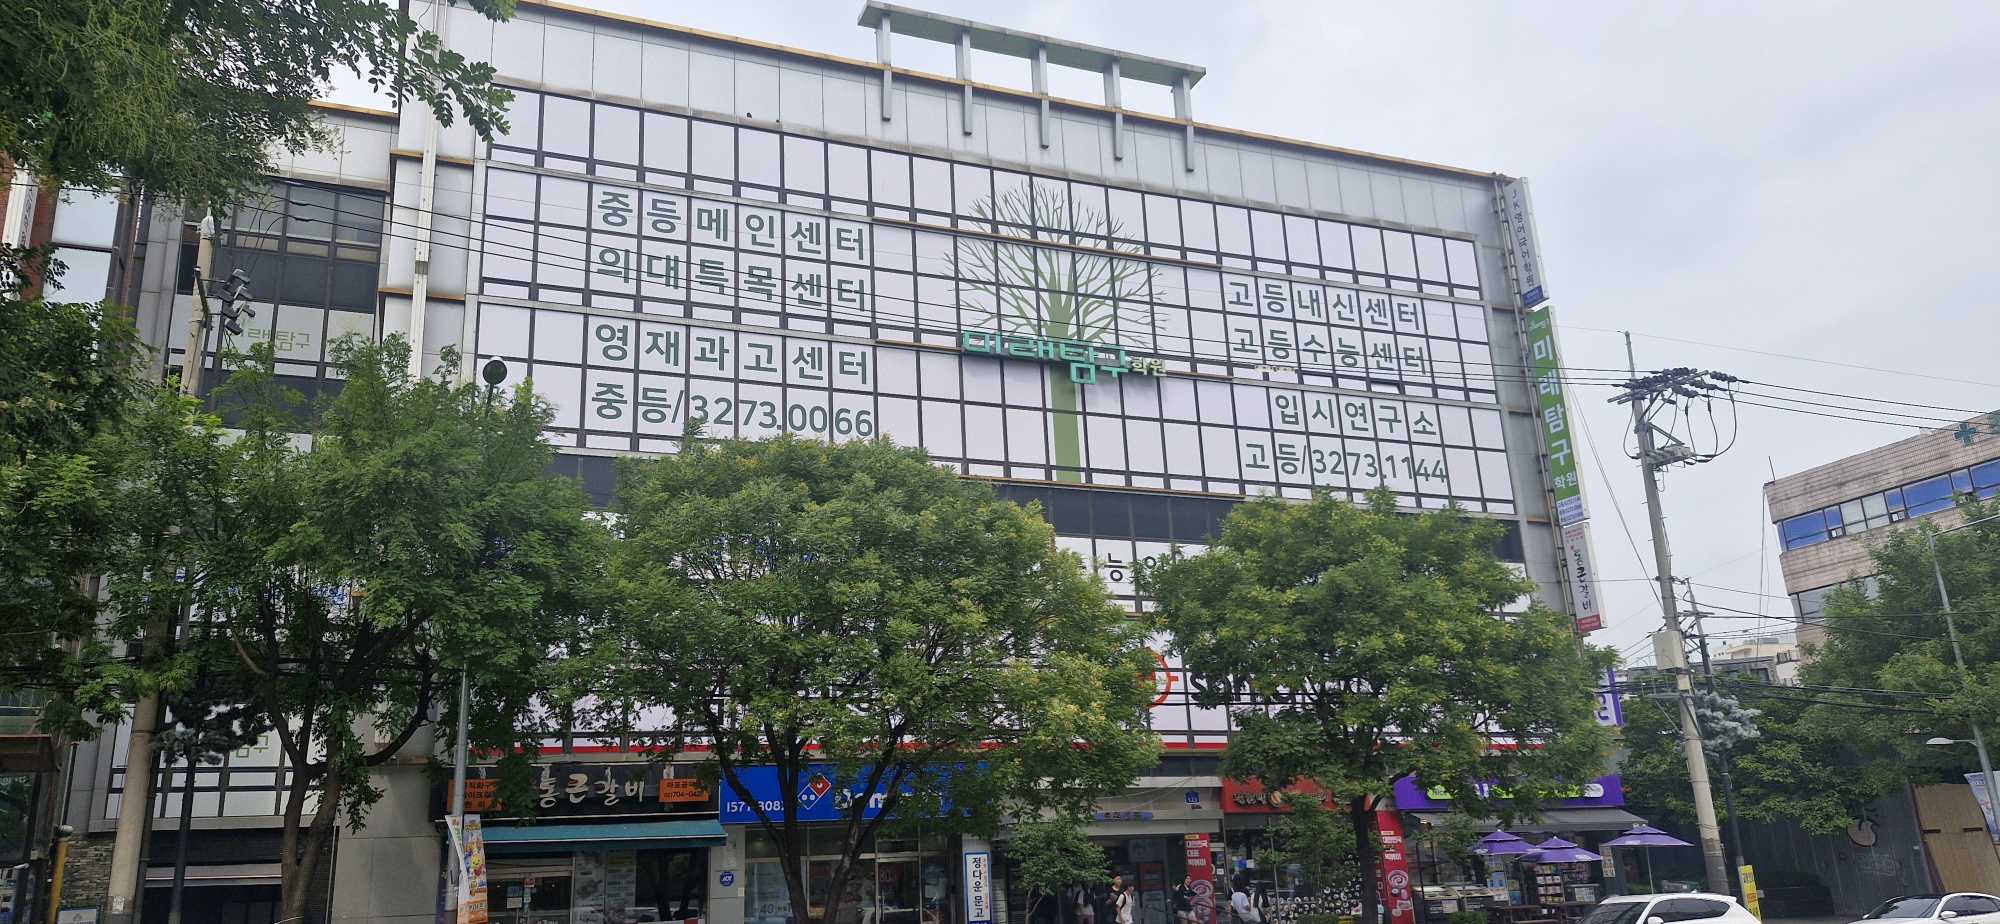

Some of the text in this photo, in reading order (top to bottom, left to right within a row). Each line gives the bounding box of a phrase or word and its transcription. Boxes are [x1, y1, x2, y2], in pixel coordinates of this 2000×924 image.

[597, 191, 864, 260] 중등메인센터
[597, 247, 865, 311] 의대특목센터
[1228, 281, 1421, 331] 고등내신센터
[242, 328, 310, 352] 래탐구
[595, 323, 867, 384] 영재과고센터
[962, 329, 1168, 384] 미래탐구 학원
[1233, 327, 1426, 375] 고등수능센터
[591, 382, 873, 437] 중등/3273.0066
[1275, 394, 1437, 436] 입시연구소
[1533, 335, 1571, 466] 미래탐구
[1554, 472, 1577, 489] 학원
[1245, 443, 1448, 483] 고등/3273.1144
[539, 767, 645, 808] 통큰갈비
[972, 857, 985, 918] 정다운문고
